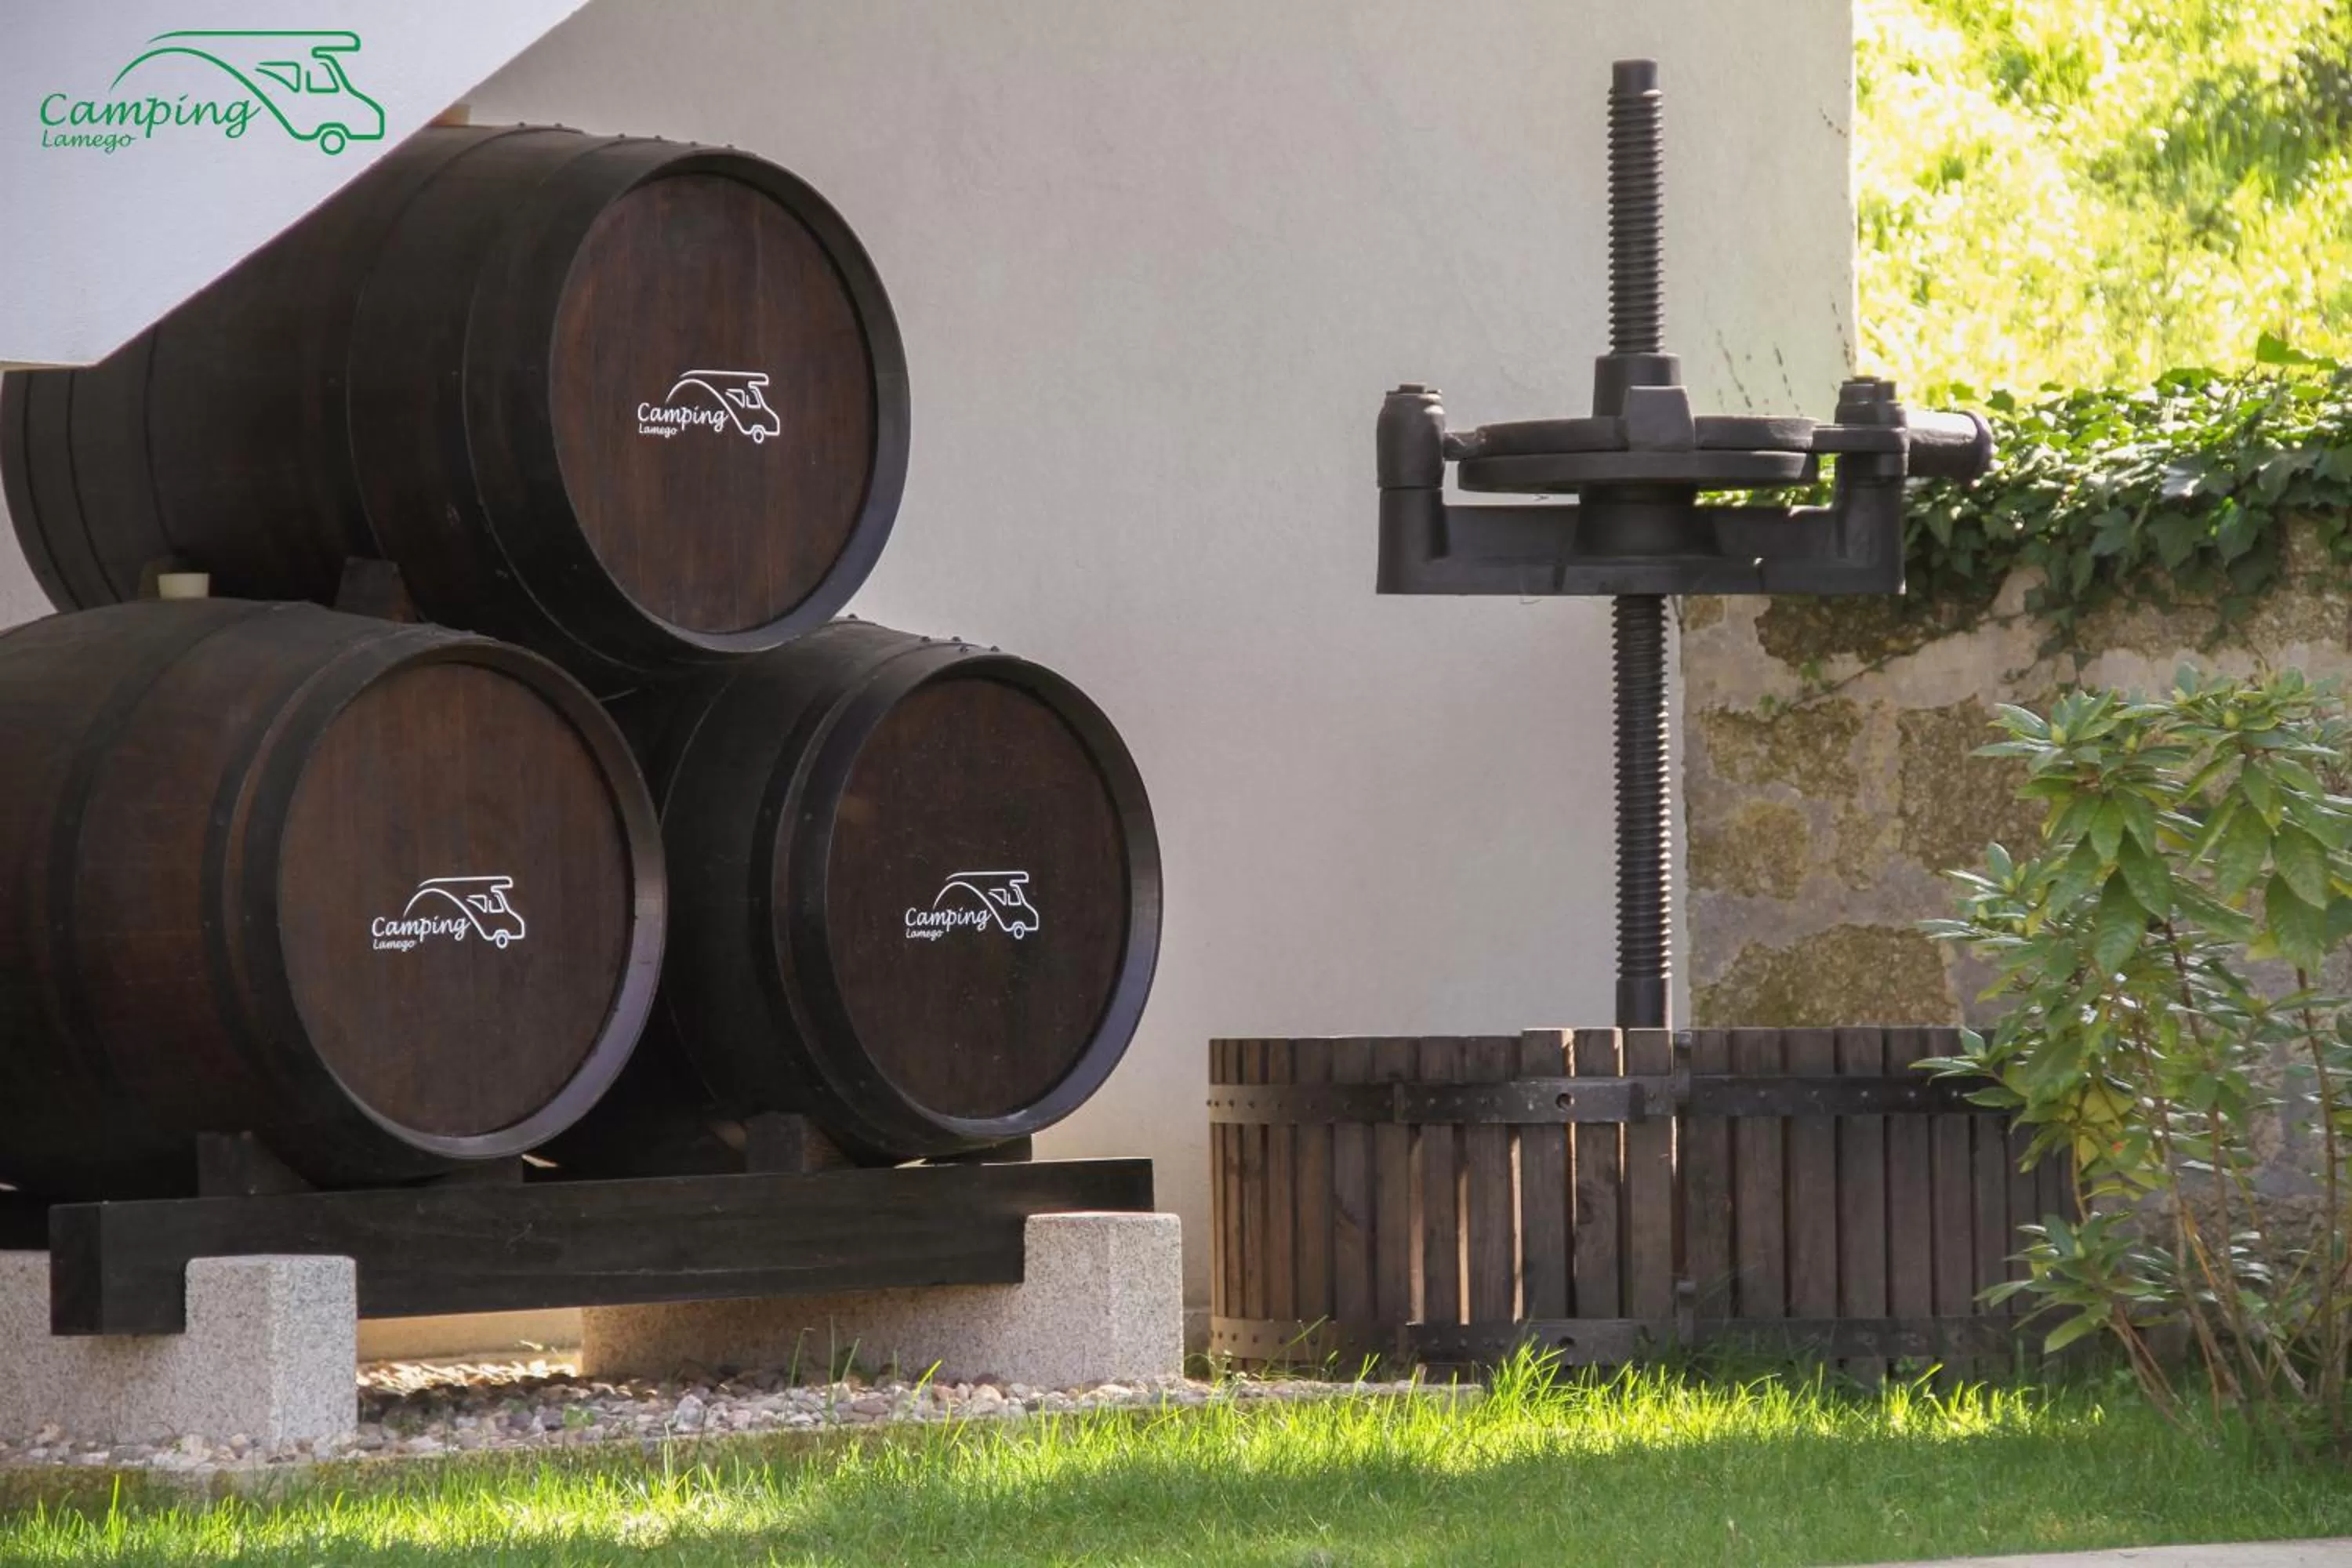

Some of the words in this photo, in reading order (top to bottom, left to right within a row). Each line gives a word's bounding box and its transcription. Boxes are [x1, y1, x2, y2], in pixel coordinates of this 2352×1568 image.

[40, 93, 261, 138] Camping
[42, 129, 136, 154] Lamego
[637, 402, 729, 433] Camping
[639, 423, 677, 438] Lamego
[372, 916, 470, 942] Camping
[905, 907, 991, 931] Camping
[373, 938, 416, 952] Lamego
[906, 928, 943, 941] Lamego
